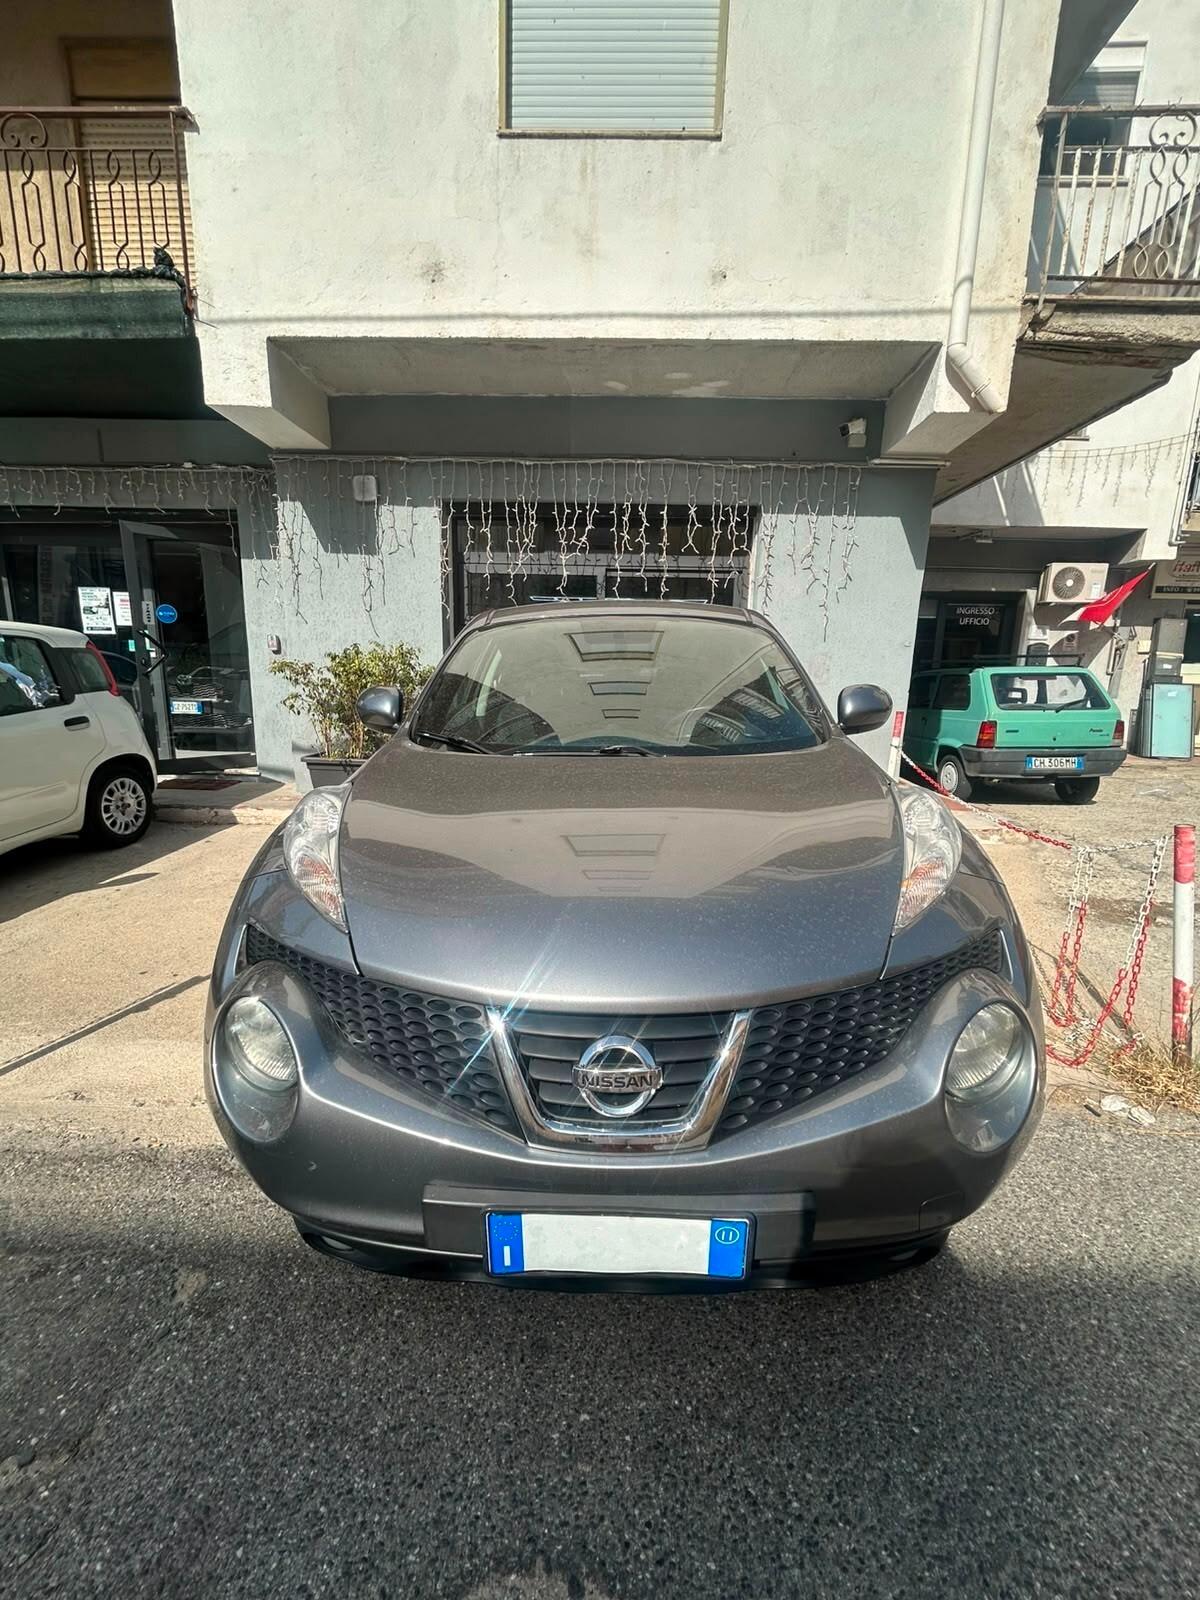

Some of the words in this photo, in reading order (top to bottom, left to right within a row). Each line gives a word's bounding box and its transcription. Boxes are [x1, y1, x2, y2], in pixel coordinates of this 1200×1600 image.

[956, 606, 995, 615] INGRESSO
[959, 617, 990, 626] UFFICIO
[580, 1074, 653, 1089] NISSAN
